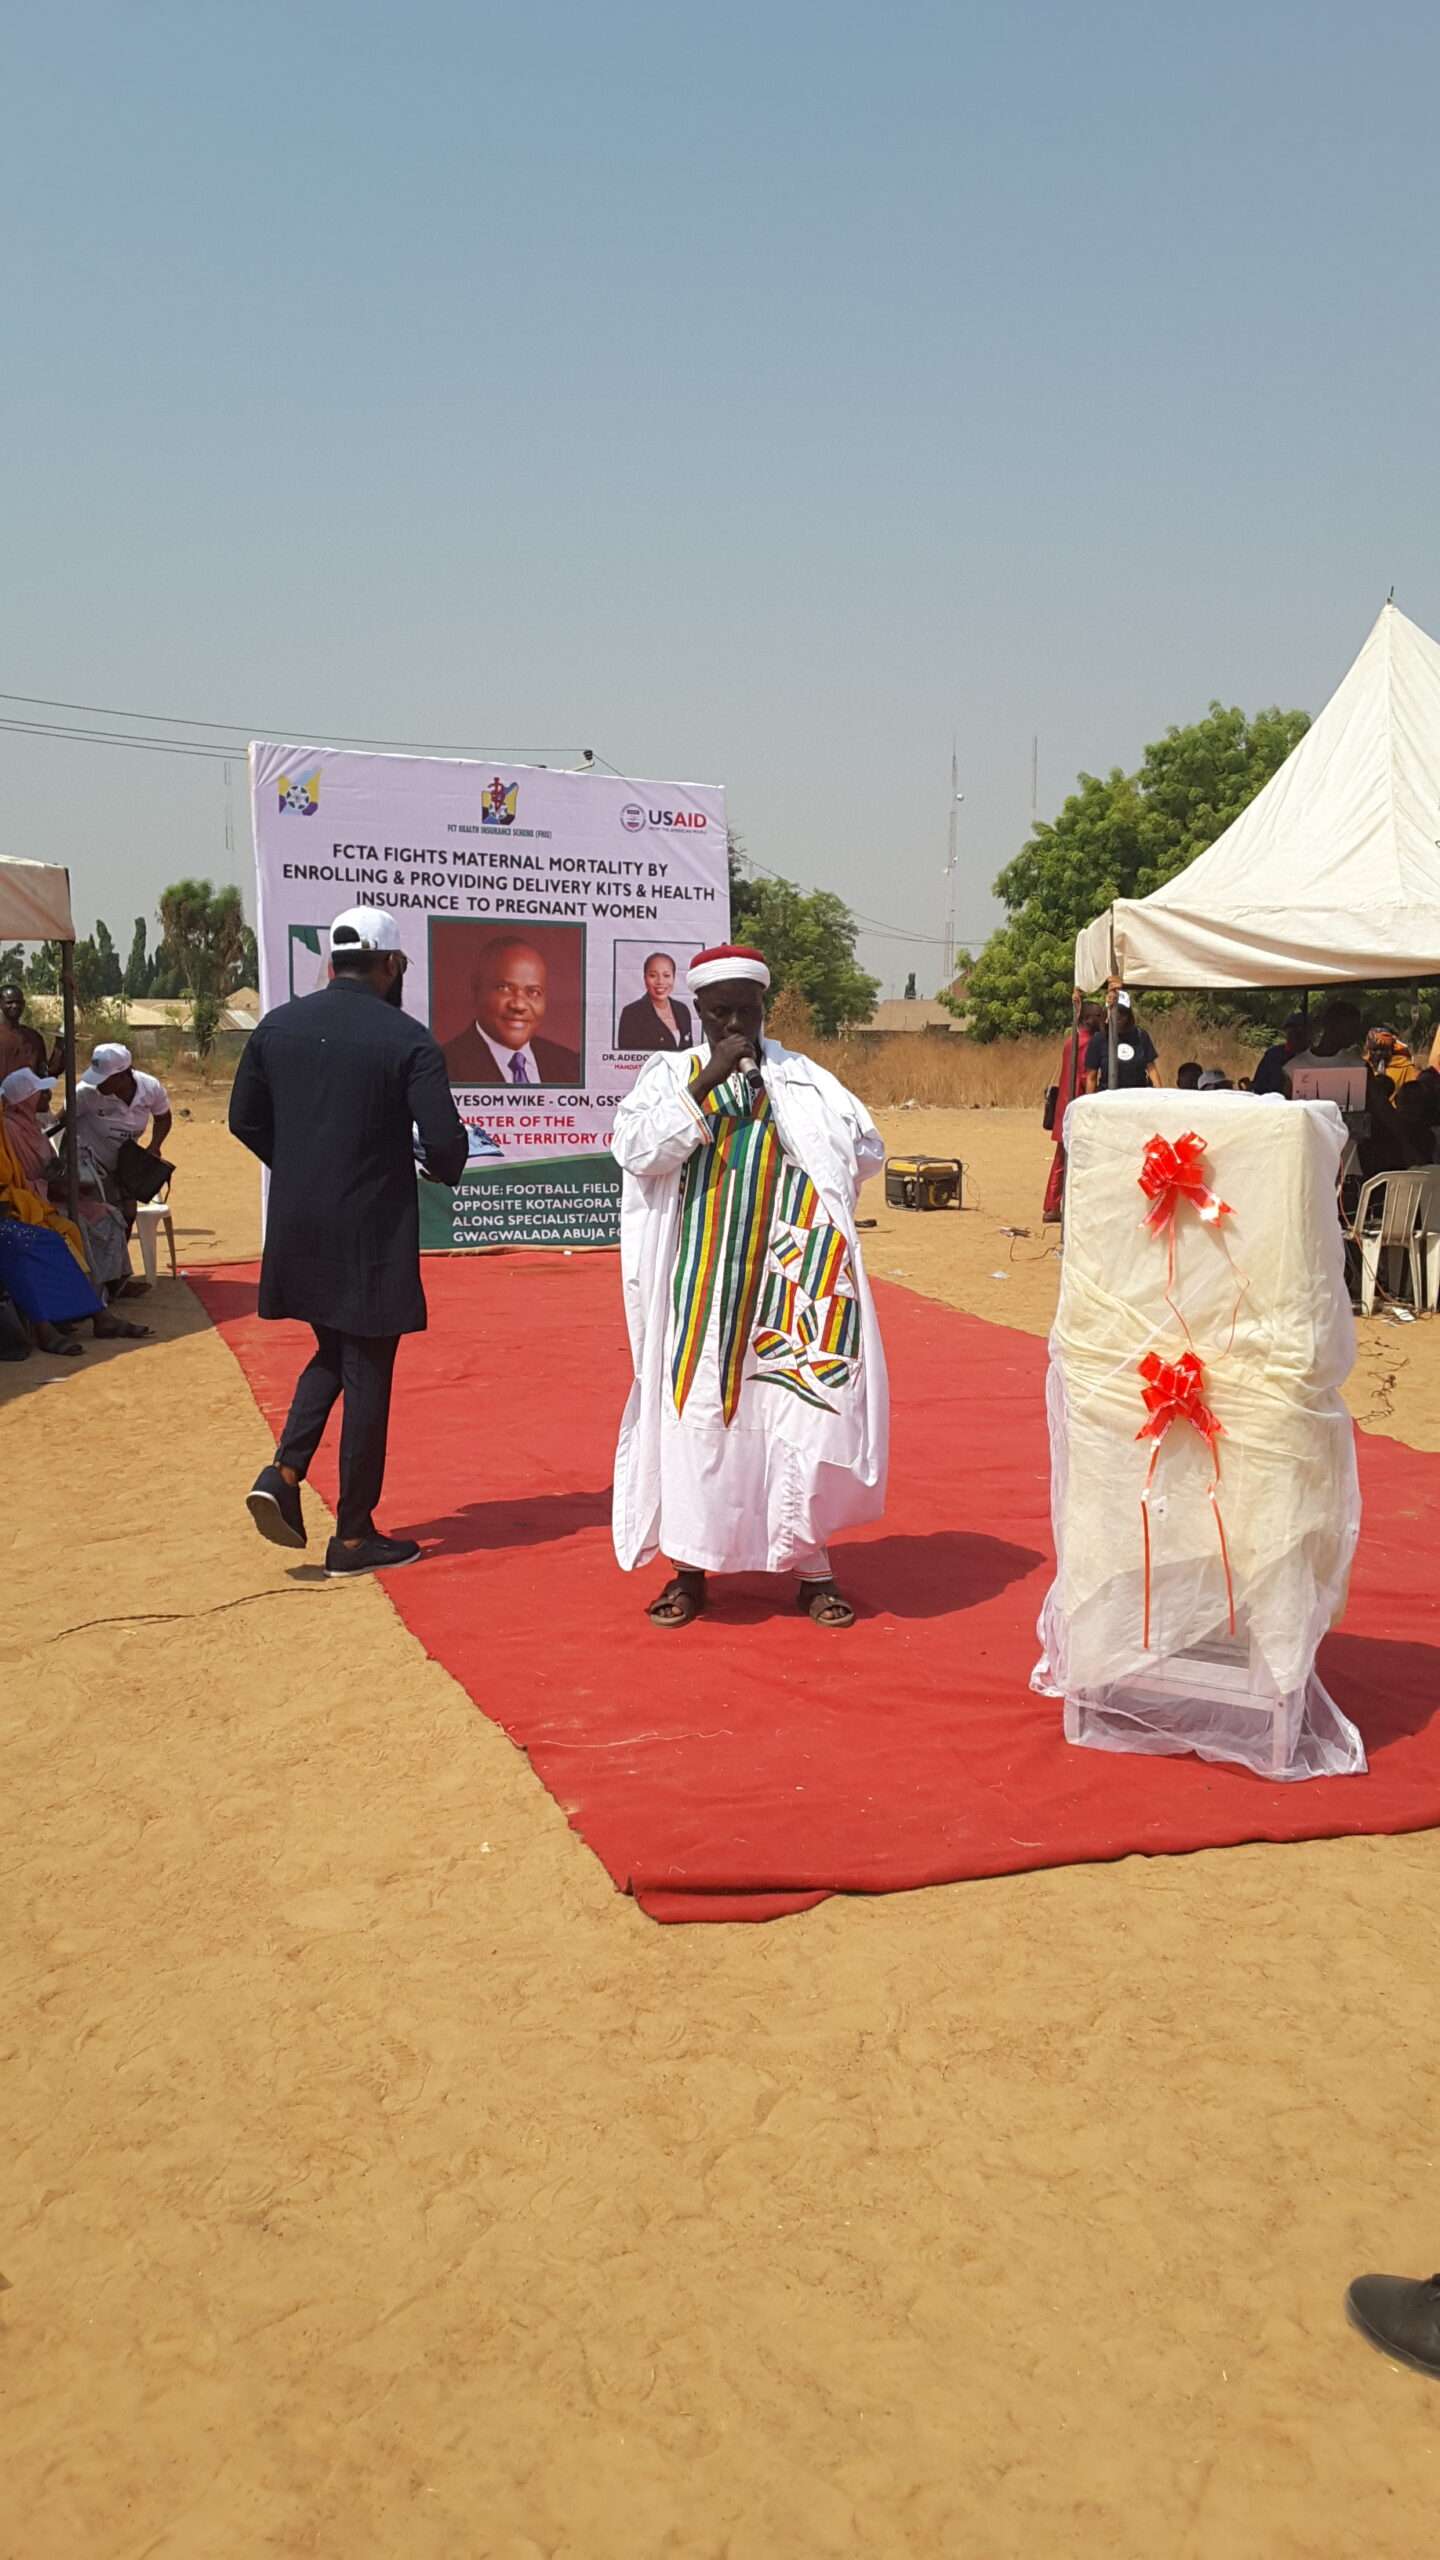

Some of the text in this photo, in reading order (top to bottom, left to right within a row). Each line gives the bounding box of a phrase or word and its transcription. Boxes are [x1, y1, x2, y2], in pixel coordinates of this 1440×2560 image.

[648, 809, 707, 828] USAID
[458, 824, 479, 834] HEALTH
[481, 826, 511, 836] INSURANCE
[332, 843, 668, 877] FCTA FIGHTS MATERNAL MORTALITY BY
[282, 864, 715, 901] ENROLLING & PROVIDING DELIVERY KITS & HEALTH
[356, 891, 657, 919] INSURANCE TO PREGNANT WOMEN
[506, 1095, 545, 1106] WIKE
[557, 1095, 594, 1109] CON,
[596, 1095, 626, 1107] GSS
[519, 1115, 541, 1127] OF
[543, 1115, 576, 1127] THE
[514, 1133, 598, 1145] TERRITORY
[452, 1183, 619, 1196] VENUE: FOOTBALL FIELD
[452, 1199, 522, 1211] OPPOSITE
[526, 1198, 612, 1210] KOTANGORA
[452, 1215, 504, 1227] ALONG
[453, 1229, 561, 1242] GWAGWALADA
[563, 1228, 605, 1240] ABUJA
